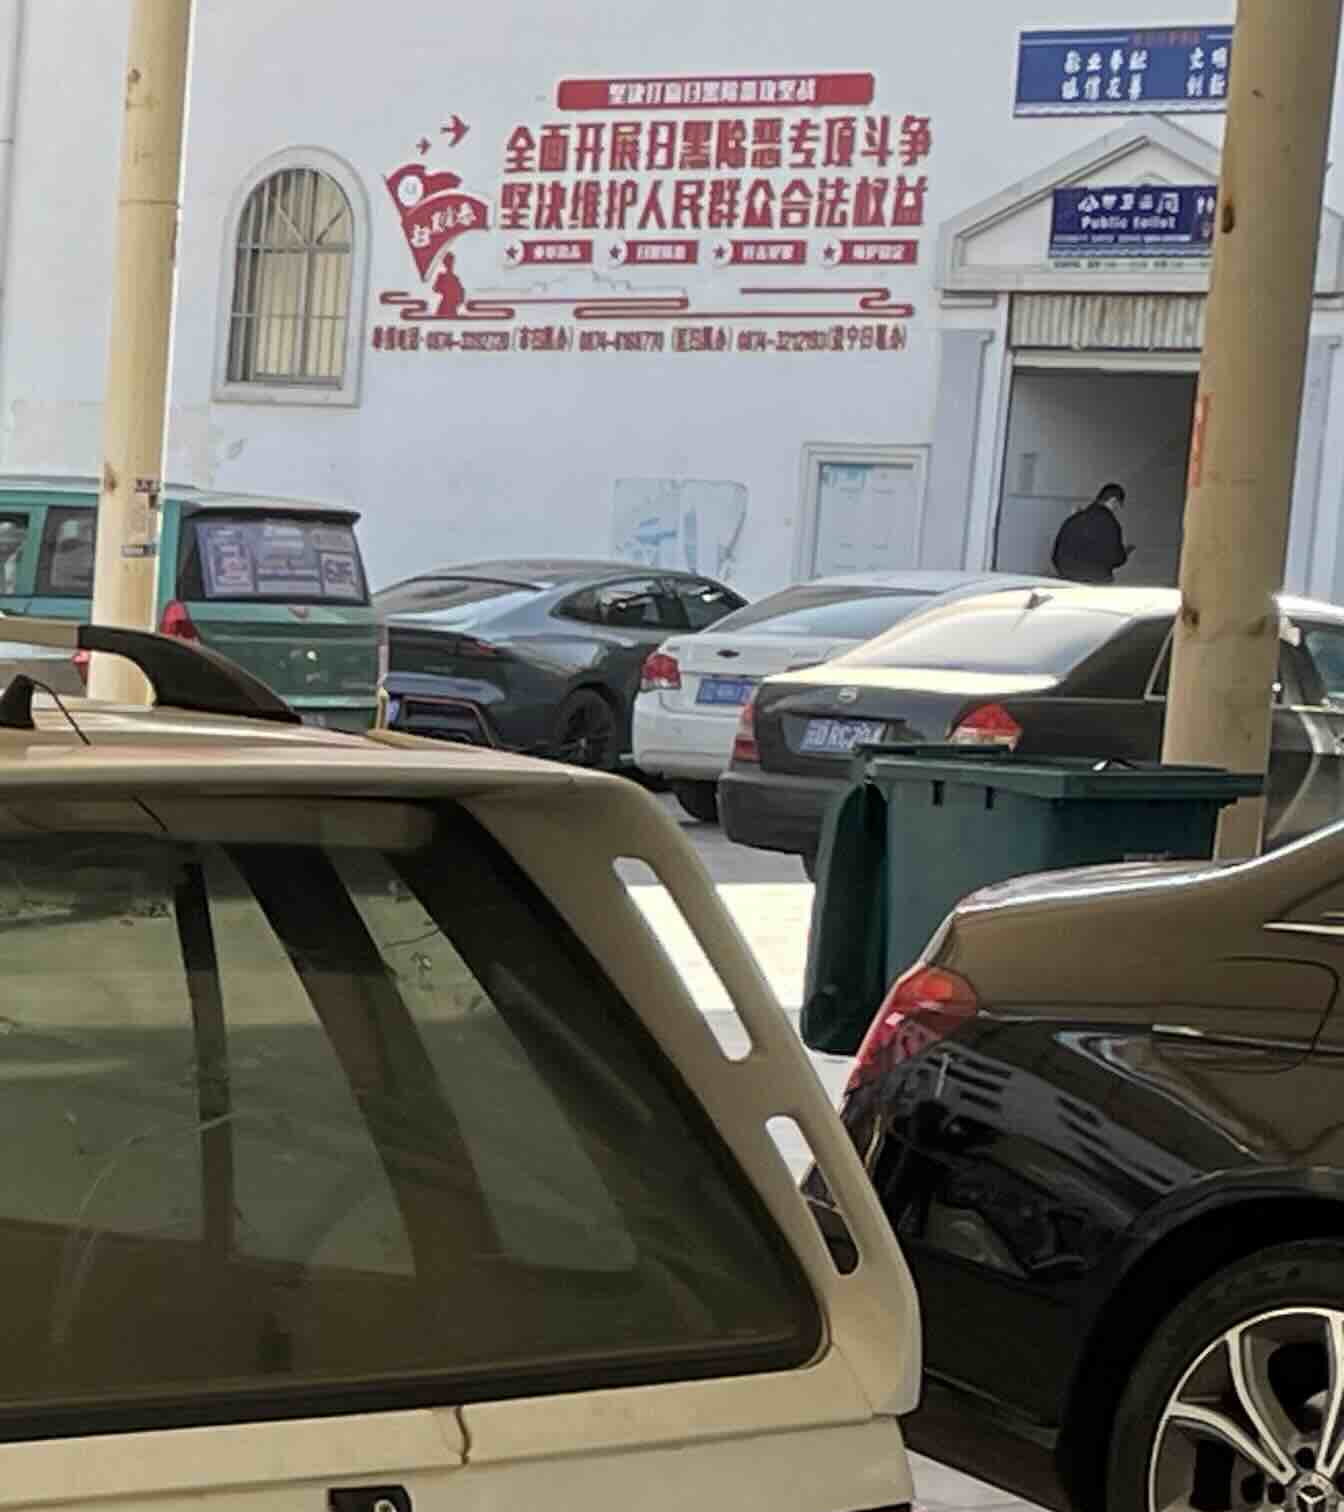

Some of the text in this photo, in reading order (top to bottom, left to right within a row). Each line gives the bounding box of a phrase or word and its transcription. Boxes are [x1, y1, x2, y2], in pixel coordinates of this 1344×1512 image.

[504, 115, 932, 173] 全面开展扫黑除恶专项斗争
[500, 175, 928, 230] 坚决维护人民群众合法权益
